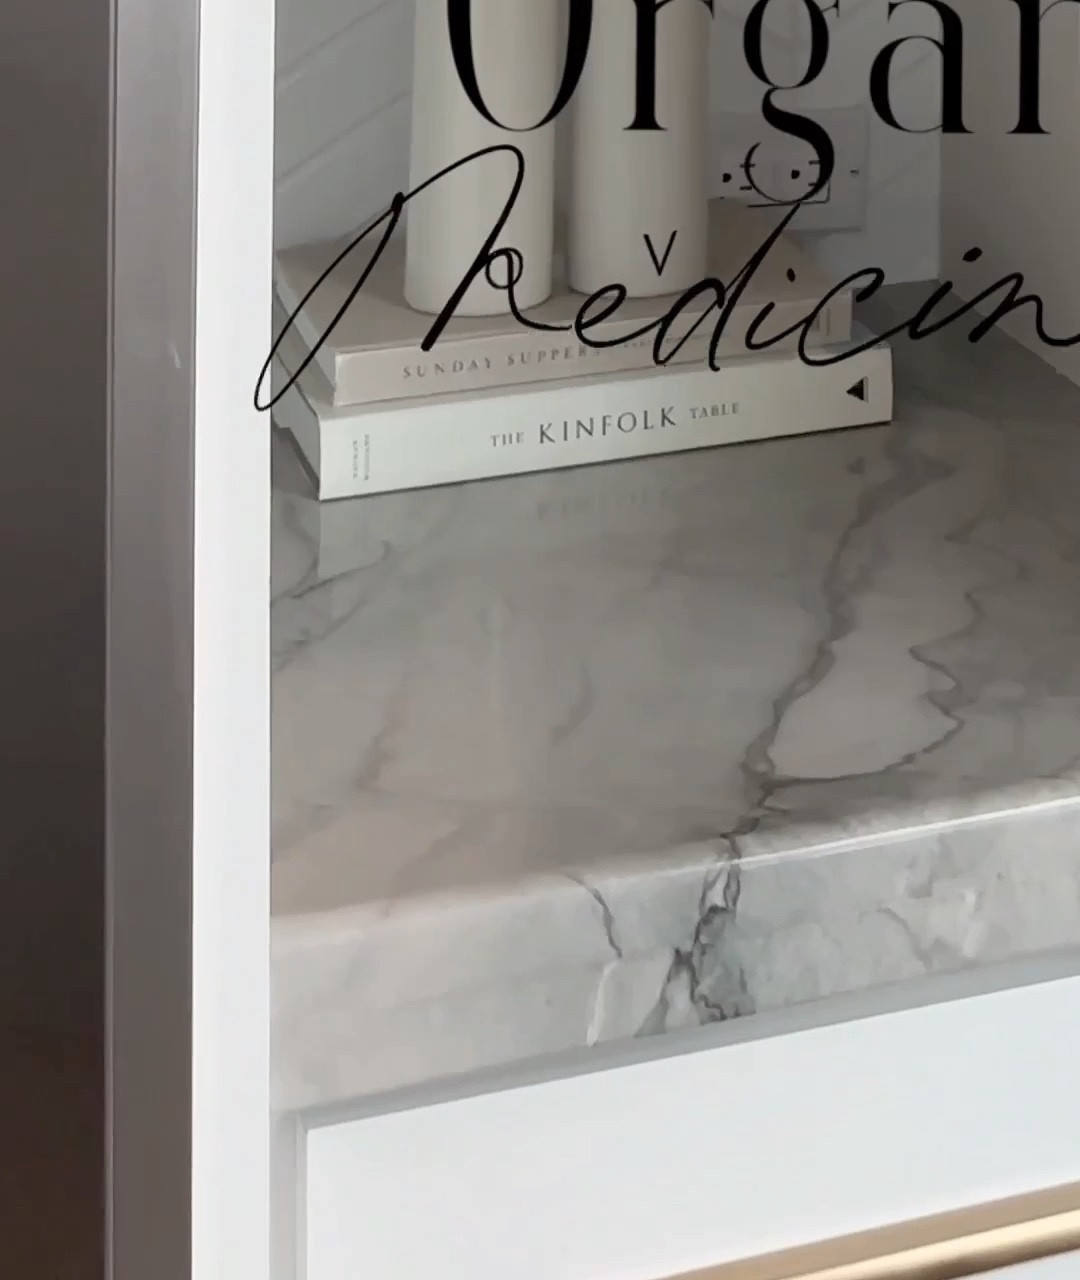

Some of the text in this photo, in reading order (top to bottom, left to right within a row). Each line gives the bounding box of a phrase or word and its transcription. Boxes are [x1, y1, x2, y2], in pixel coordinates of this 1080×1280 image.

[402, 346, 601, 380] SUNDAY SUPPER
[490, 402, 740, 447] THE KINFOLK TABLE
